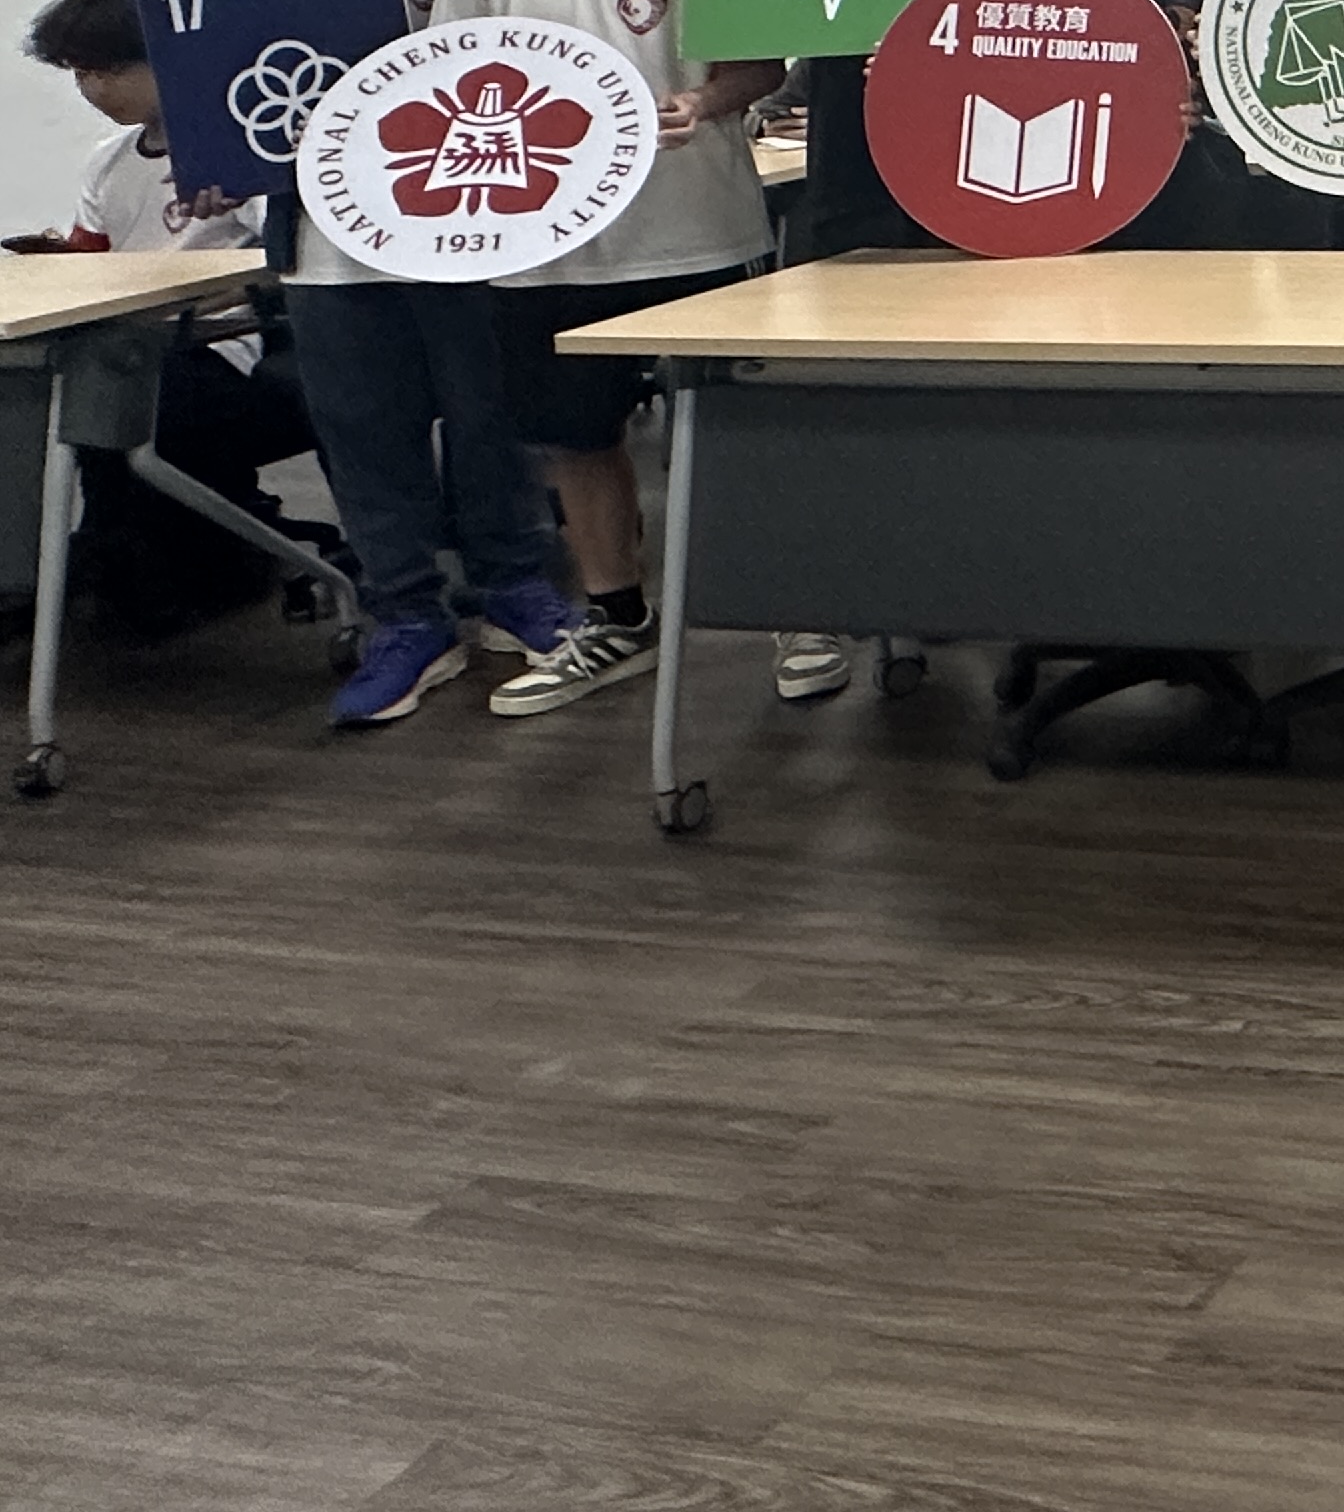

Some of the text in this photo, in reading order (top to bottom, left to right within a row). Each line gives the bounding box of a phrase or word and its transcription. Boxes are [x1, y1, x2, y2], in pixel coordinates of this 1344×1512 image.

[929, 3, 959, 55] 4
[976, 1, 1091, 33] 優質教育
[972, 35, 1138, 63] QUALITY EDUCATION
[1225, 26, 1252, 105] NATIONAL
[1247, 105, 1292, 147] CHENG
[1291, 139, 1336, 166] KUNG
[317, 108, 393, 252] NATIONAL
[358, 32, 478, 96] CHENG
[498, 30, 598, 70] KUNG
[550, 70, 640, 242] UNIVERSITY
[434, 232, 503, 253] 1931
